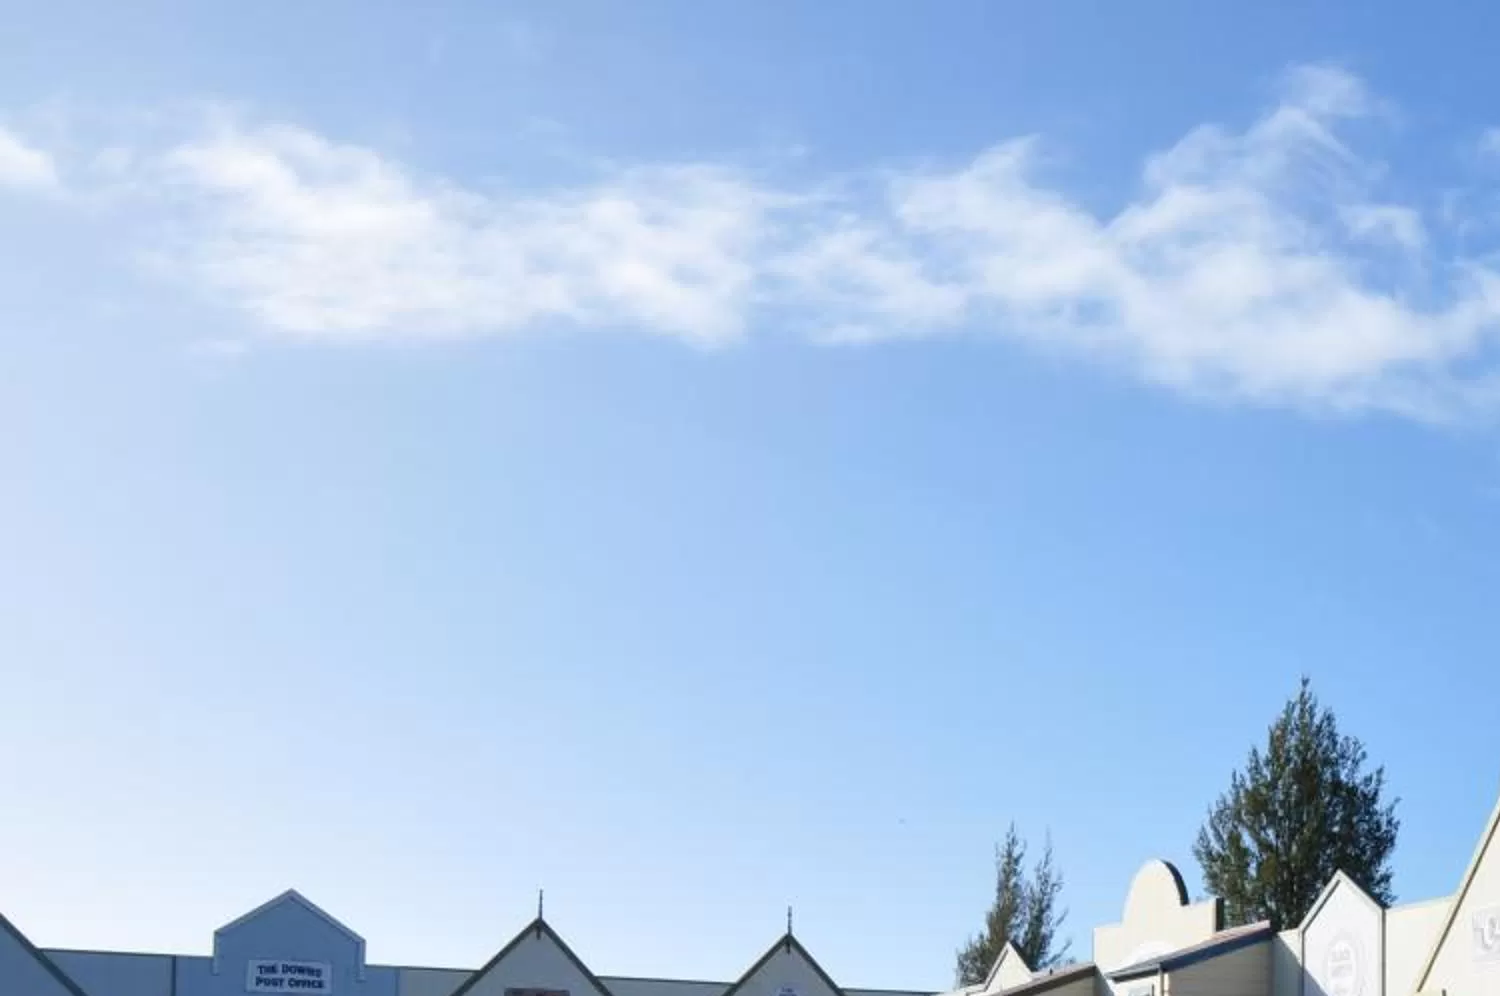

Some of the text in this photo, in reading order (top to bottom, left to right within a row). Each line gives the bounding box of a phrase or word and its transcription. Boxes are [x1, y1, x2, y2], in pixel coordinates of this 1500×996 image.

[256, 964, 278, 975] THE
[255, 976, 325, 990] POST OFFICE
